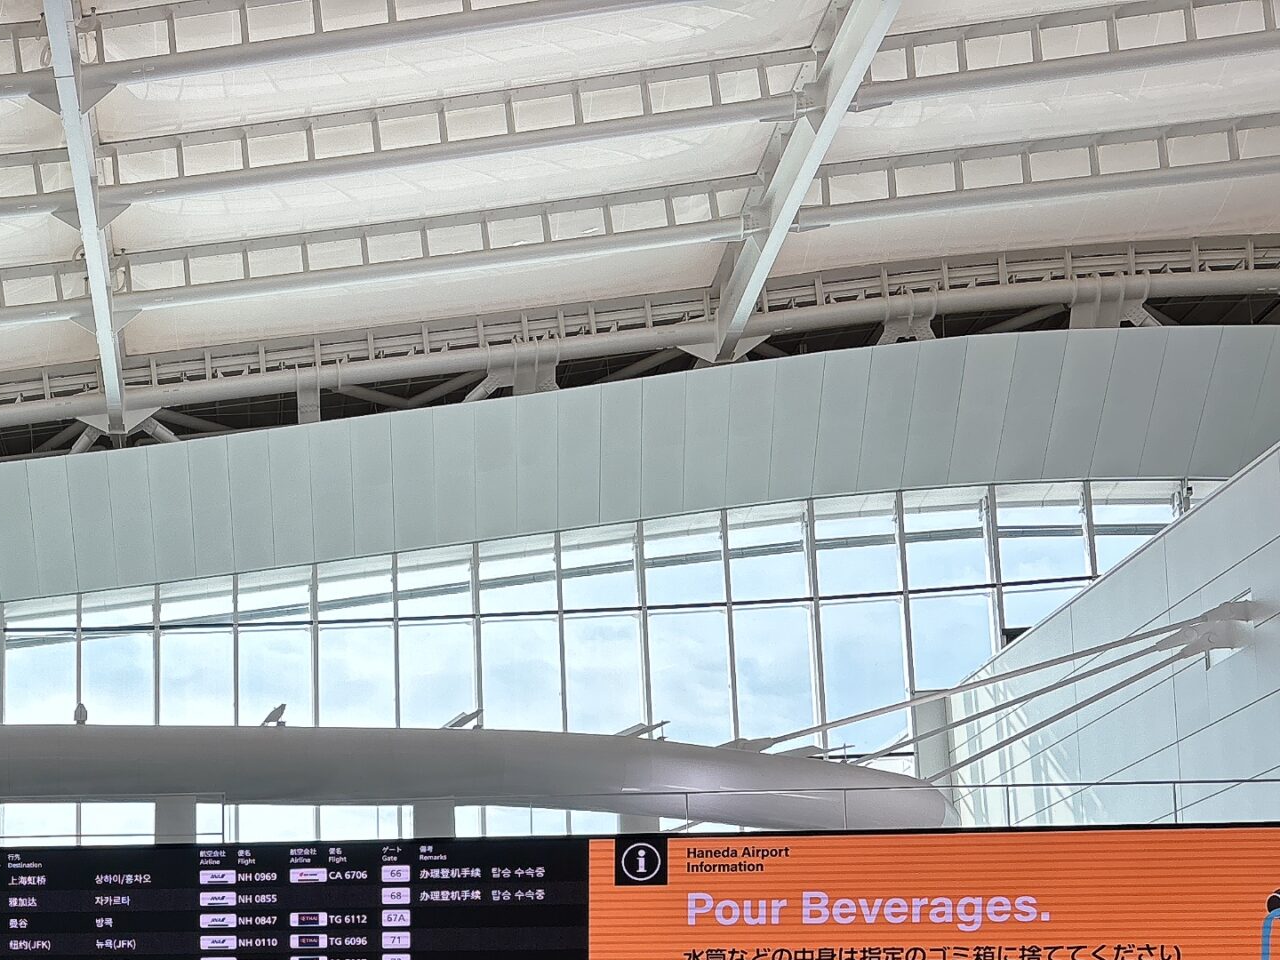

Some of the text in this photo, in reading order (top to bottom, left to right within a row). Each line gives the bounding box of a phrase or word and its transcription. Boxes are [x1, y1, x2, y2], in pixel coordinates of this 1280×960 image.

[687, 846, 789, 859] Haneda Airport
[492, 867, 545, 878] 탑승 수속중
[687, 862, 764, 873] Information
[238, 872, 277, 881] NH 0969
[329, 870, 368, 880] CA 6706
[390, 870, 402, 878] 66
[95, 896, 130, 906] 자카르타
[390, 892, 402, 900] 68
[687, 890, 1051, 932] Pour Beverages.
[238, 916, 277, 925] NH 0847
[329, 915, 368, 924] TG 6112
[387, 914, 406, 922] 67A
[96, 939, 136, 950] 뉴욕(JFK)
